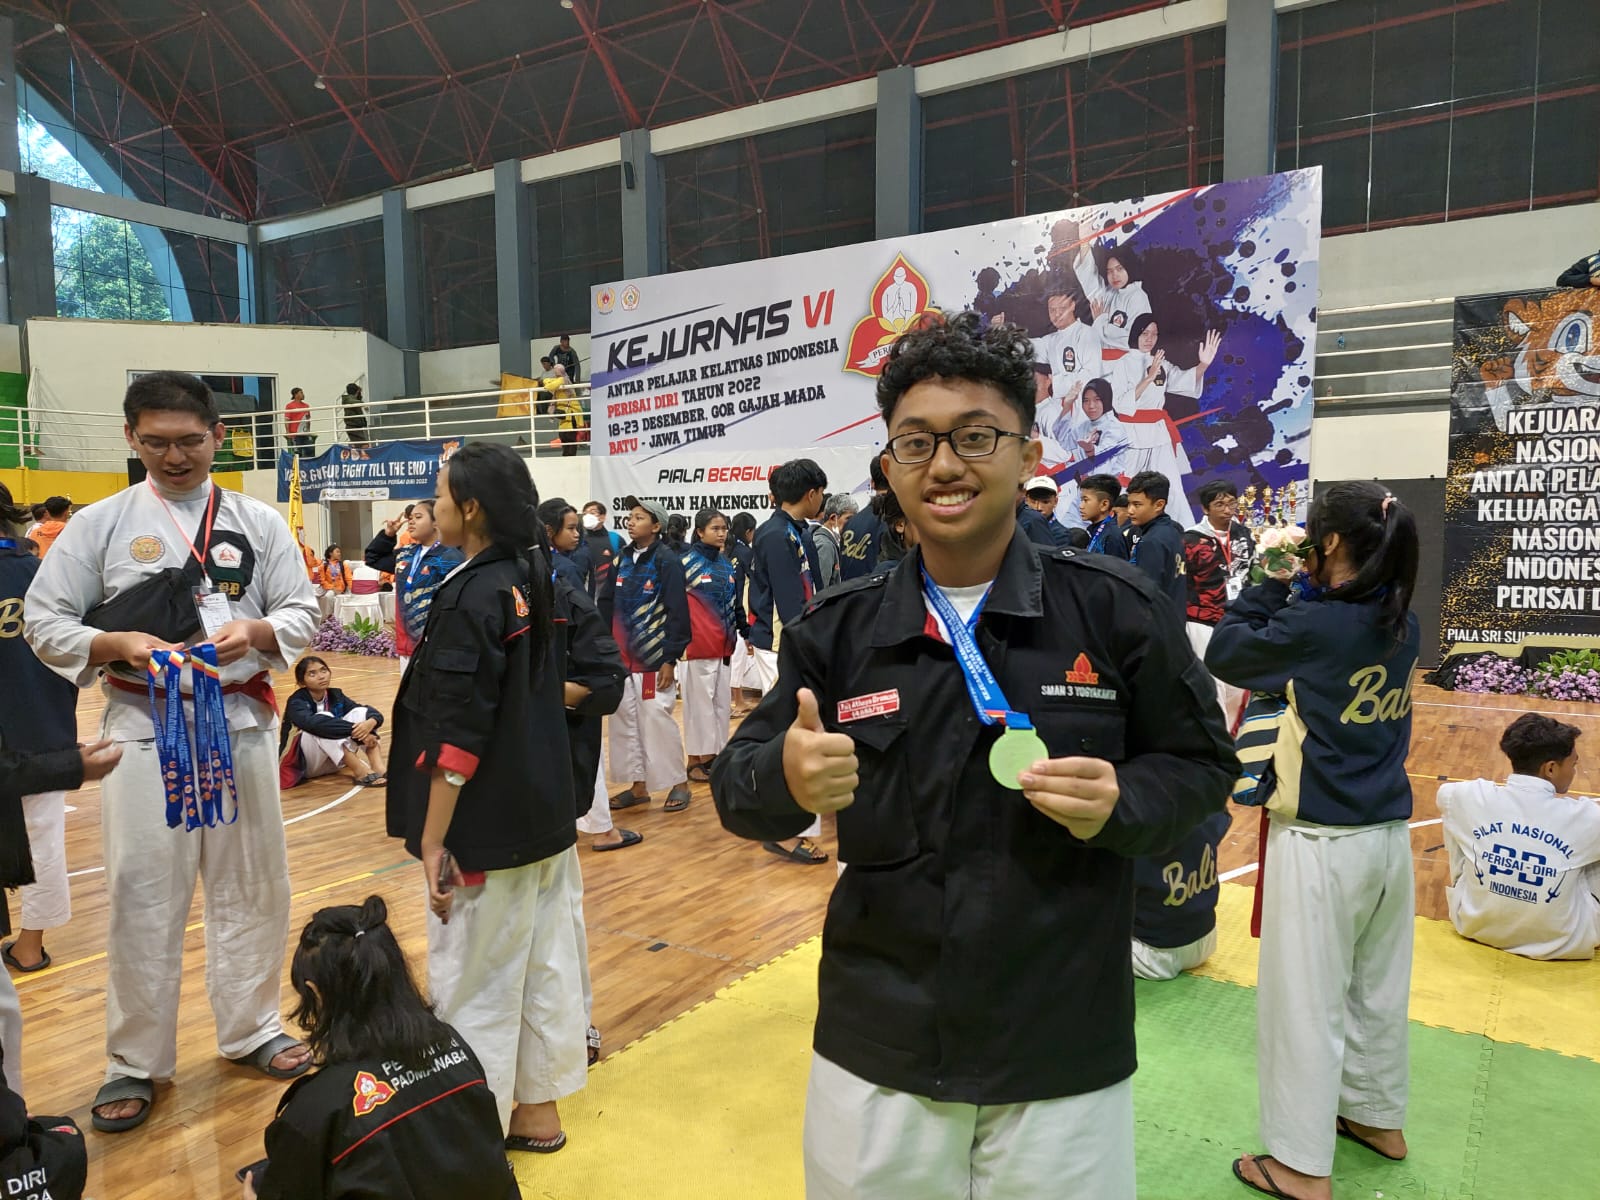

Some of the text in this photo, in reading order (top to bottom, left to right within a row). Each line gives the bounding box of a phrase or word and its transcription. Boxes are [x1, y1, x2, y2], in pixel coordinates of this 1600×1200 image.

[607, 289, 835, 373] KEJURNAS VI
[607, 338, 839, 399] ANTAR PELAJAR KELATNAS INDONESIA
[607, 376, 761, 418] PERISAI DIRI TAHUN 2022
[608, 417, 639, 437] 18-23
[711, 401, 735, 419] GOR
[738, 392, 781, 414] GAJAH
[783, 385, 826, 405] MADA
[609, 437, 638, 456] BATU
[649, 429, 680, 449] JAWA
[684, 422, 726, 443] TIMUR
[342, 463, 366, 478] FIGHT
[369, 462, 387, 477] TILL
[389, 461, 405, 477] THE
[408, 460, 426, 476] END
[658, 467, 704, 484] PIALA
[1470, 470, 1545, 493] ANTAR
[1477, 497, 1599, 522] KELUARGA
[1512, 527, 1600, 551] NASION
[1496, 585, 1585, 610] PERISAI
[1447, 628, 1479, 642] PIALA
[1482, 629, 1501, 643] SRI
[1041, 685, 1066, 696] SMAN
[1067, 686, 1073, 696] 3
[1340, 656, 1419, 724] Bal
[1472, 822, 1575, 860] SILAT NASIONAL
[1162, 842, 1218, 906] Bali
[1489, 880, 1538, 903] INDONESIA
[7, 1167, 47, 1195] DIRI
